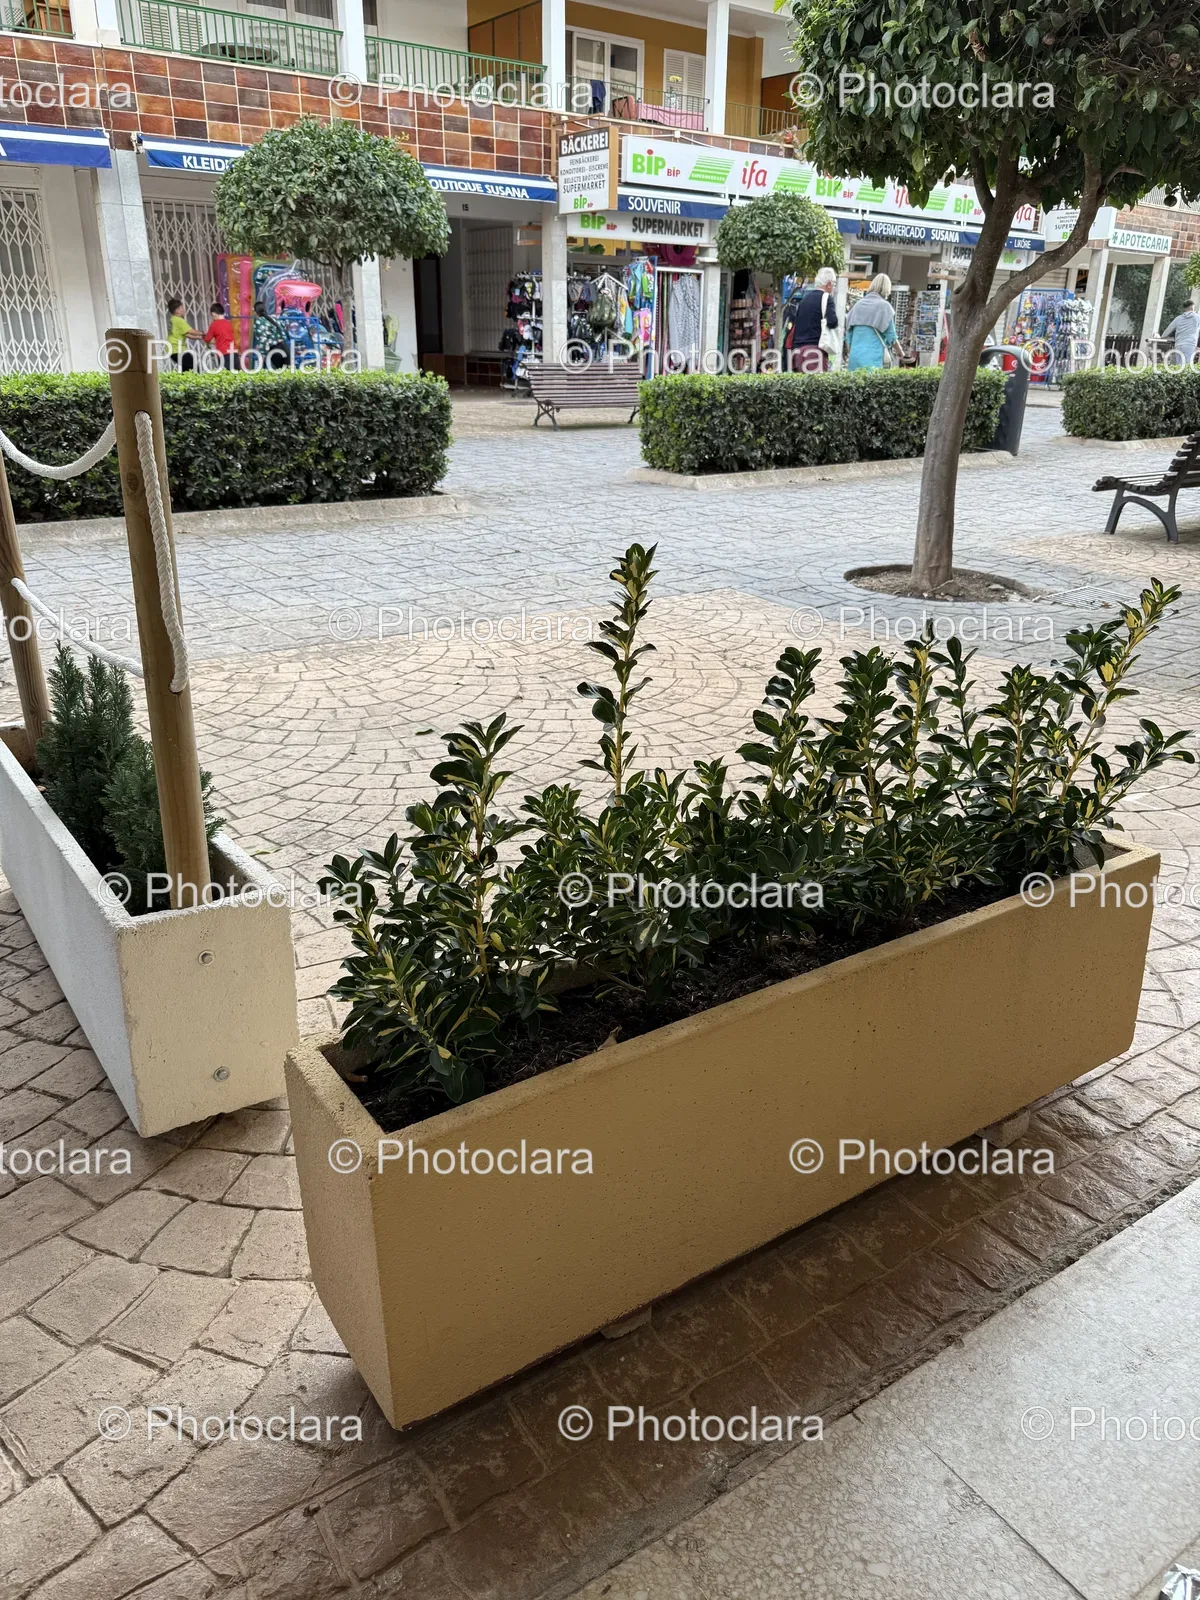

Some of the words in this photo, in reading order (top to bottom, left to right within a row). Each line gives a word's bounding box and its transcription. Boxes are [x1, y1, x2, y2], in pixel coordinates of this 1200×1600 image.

[561, 132, 608, 155] BÄCKEREI
[741, 160, 767, 189] ifa
[429, 179, 484, 193] OUTIQUE
[486, 184, 529, 199] SUSANA
[563, 180, 605, 194] SUPERMARKET
[462, 203, 469, 211] 15
[628, 196, 681, 214] SOUVENIR
[632, 216, 705, 237] SUPERMARKET
[869, 221, 926, 239] SUPERMERCADO
[931, 229, 960, 243] SUSANA
[1120, 233, 1169, 252] APOTECARIA
